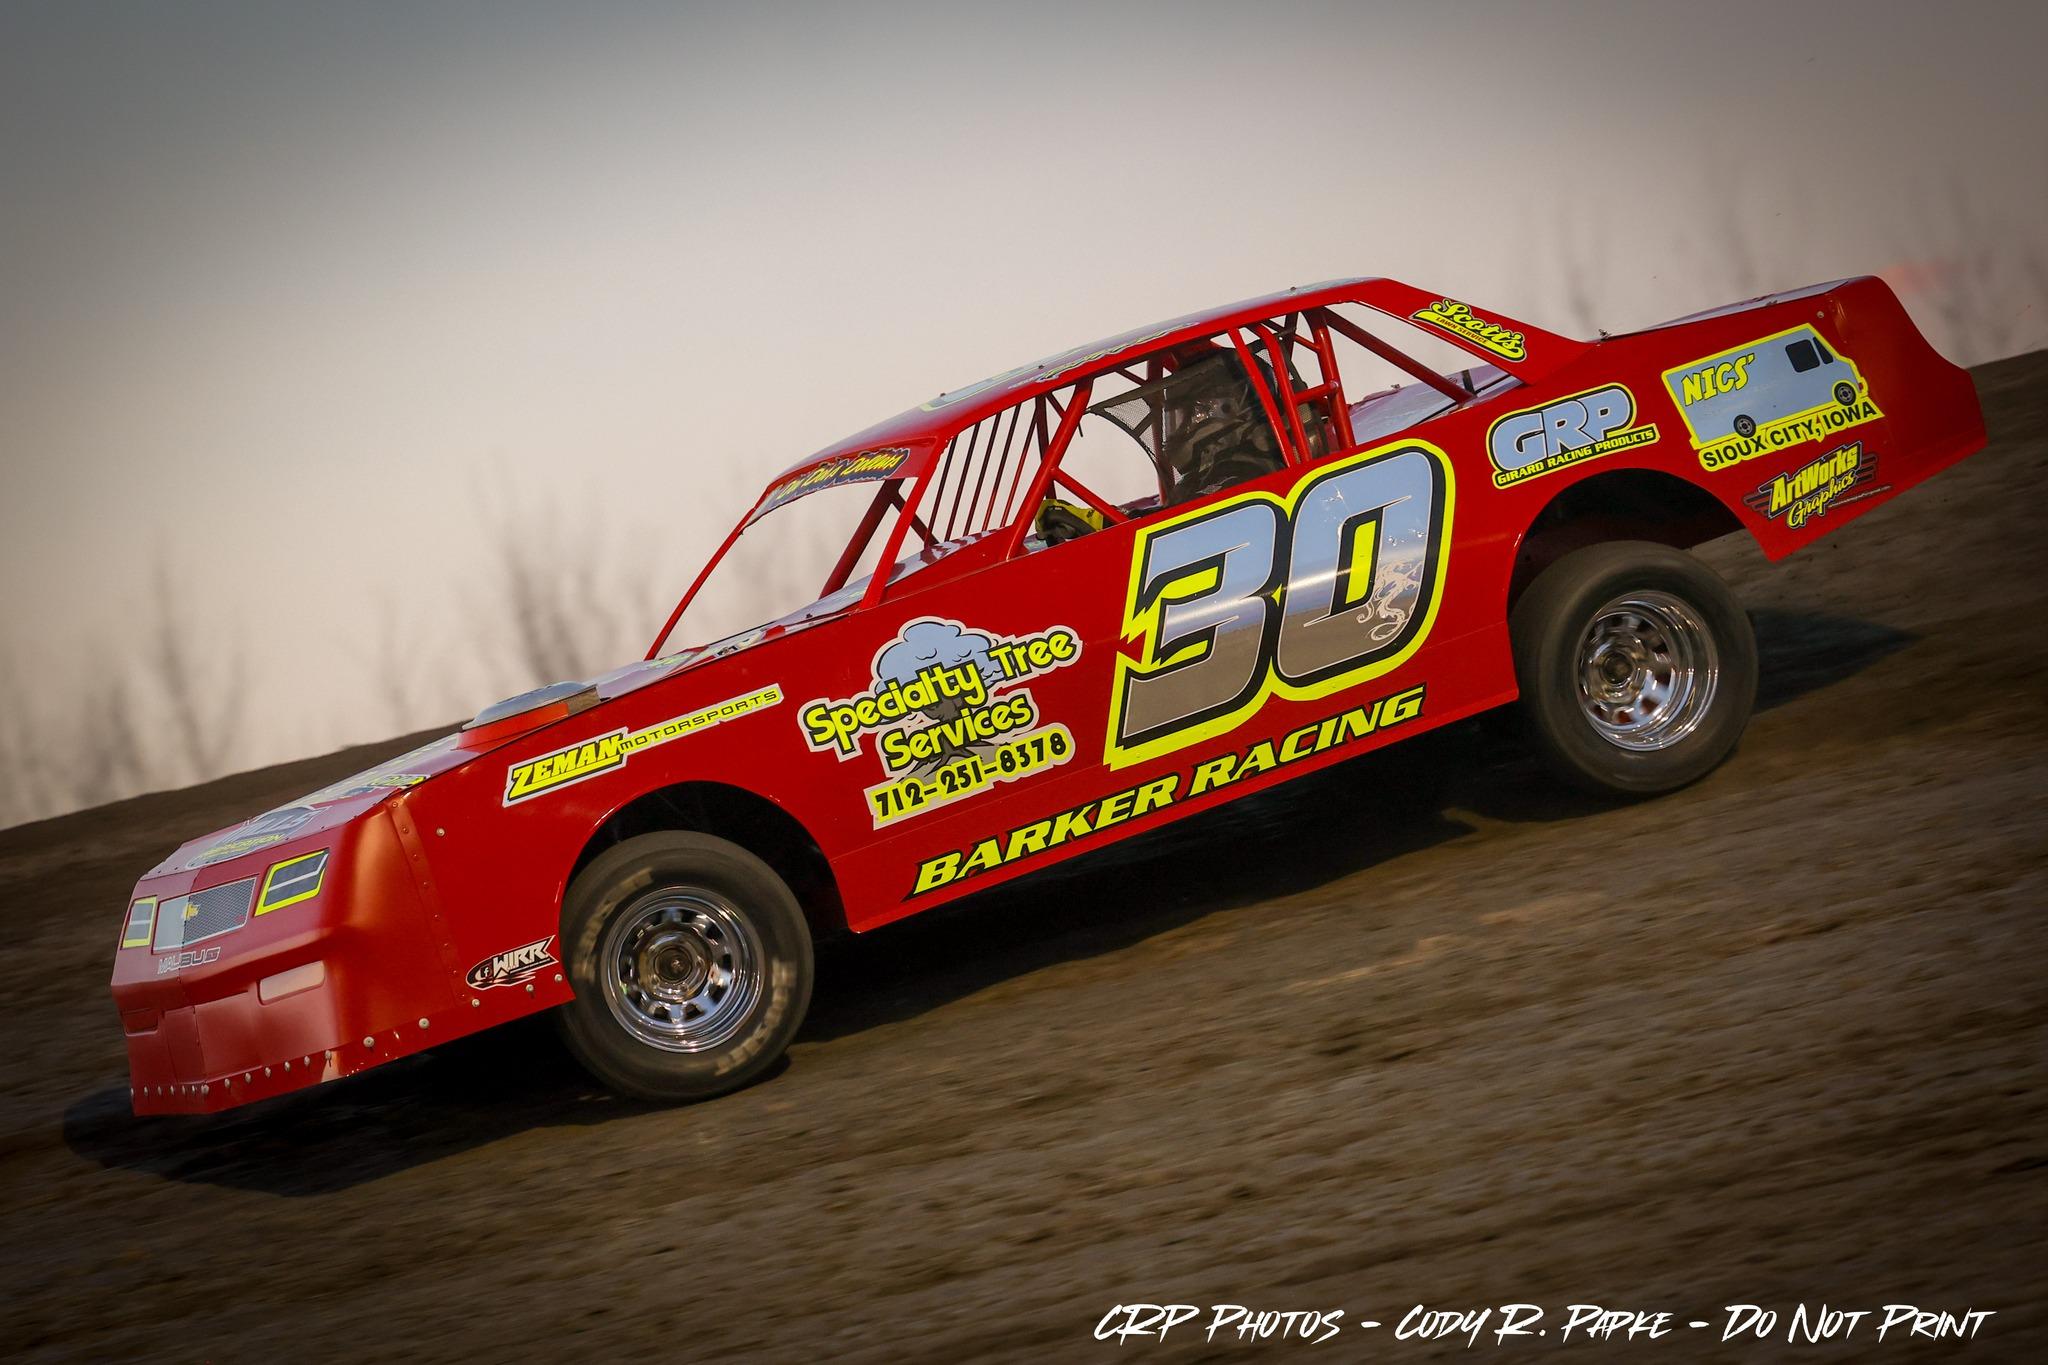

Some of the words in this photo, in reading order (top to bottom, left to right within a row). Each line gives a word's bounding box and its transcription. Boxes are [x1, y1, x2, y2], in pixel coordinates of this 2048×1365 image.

[1430, 299, 1524, 352] Scott's
[1457, 327, 1488, 345] SERVICE
[1492, 388, 1631, 471] GRP
[1497, 461, 1545, 485] GIRARD
[1547, 447, 1593, 468] RACING
[1594, 429, 1655, 453] PRODUCTS
[1702, 437, 1766, 468] SIOUX
[1769, 419, 1822, 446] CITY,
[1823, 401, 1878, 430] IOWA
[1770, 445, 1859, 513] ArtWorks
[1787, 471, 1857, 527] Graphics
[1112, 443, 1450, 760] 30
[804, 661, 988, 753] Specialty
[989, 630, 1076, 680] Tree
[508, 733, 625, 800] ZEMAN
[619, 690, 778, 751] MOTORSPORTS
[880, 694, 1033, 771] Services
[874, 731, 1068, 818] 712-251-8378
[912, 774, 1180, 895] BARKER
[1188, 686, 1424, 797] RACING
